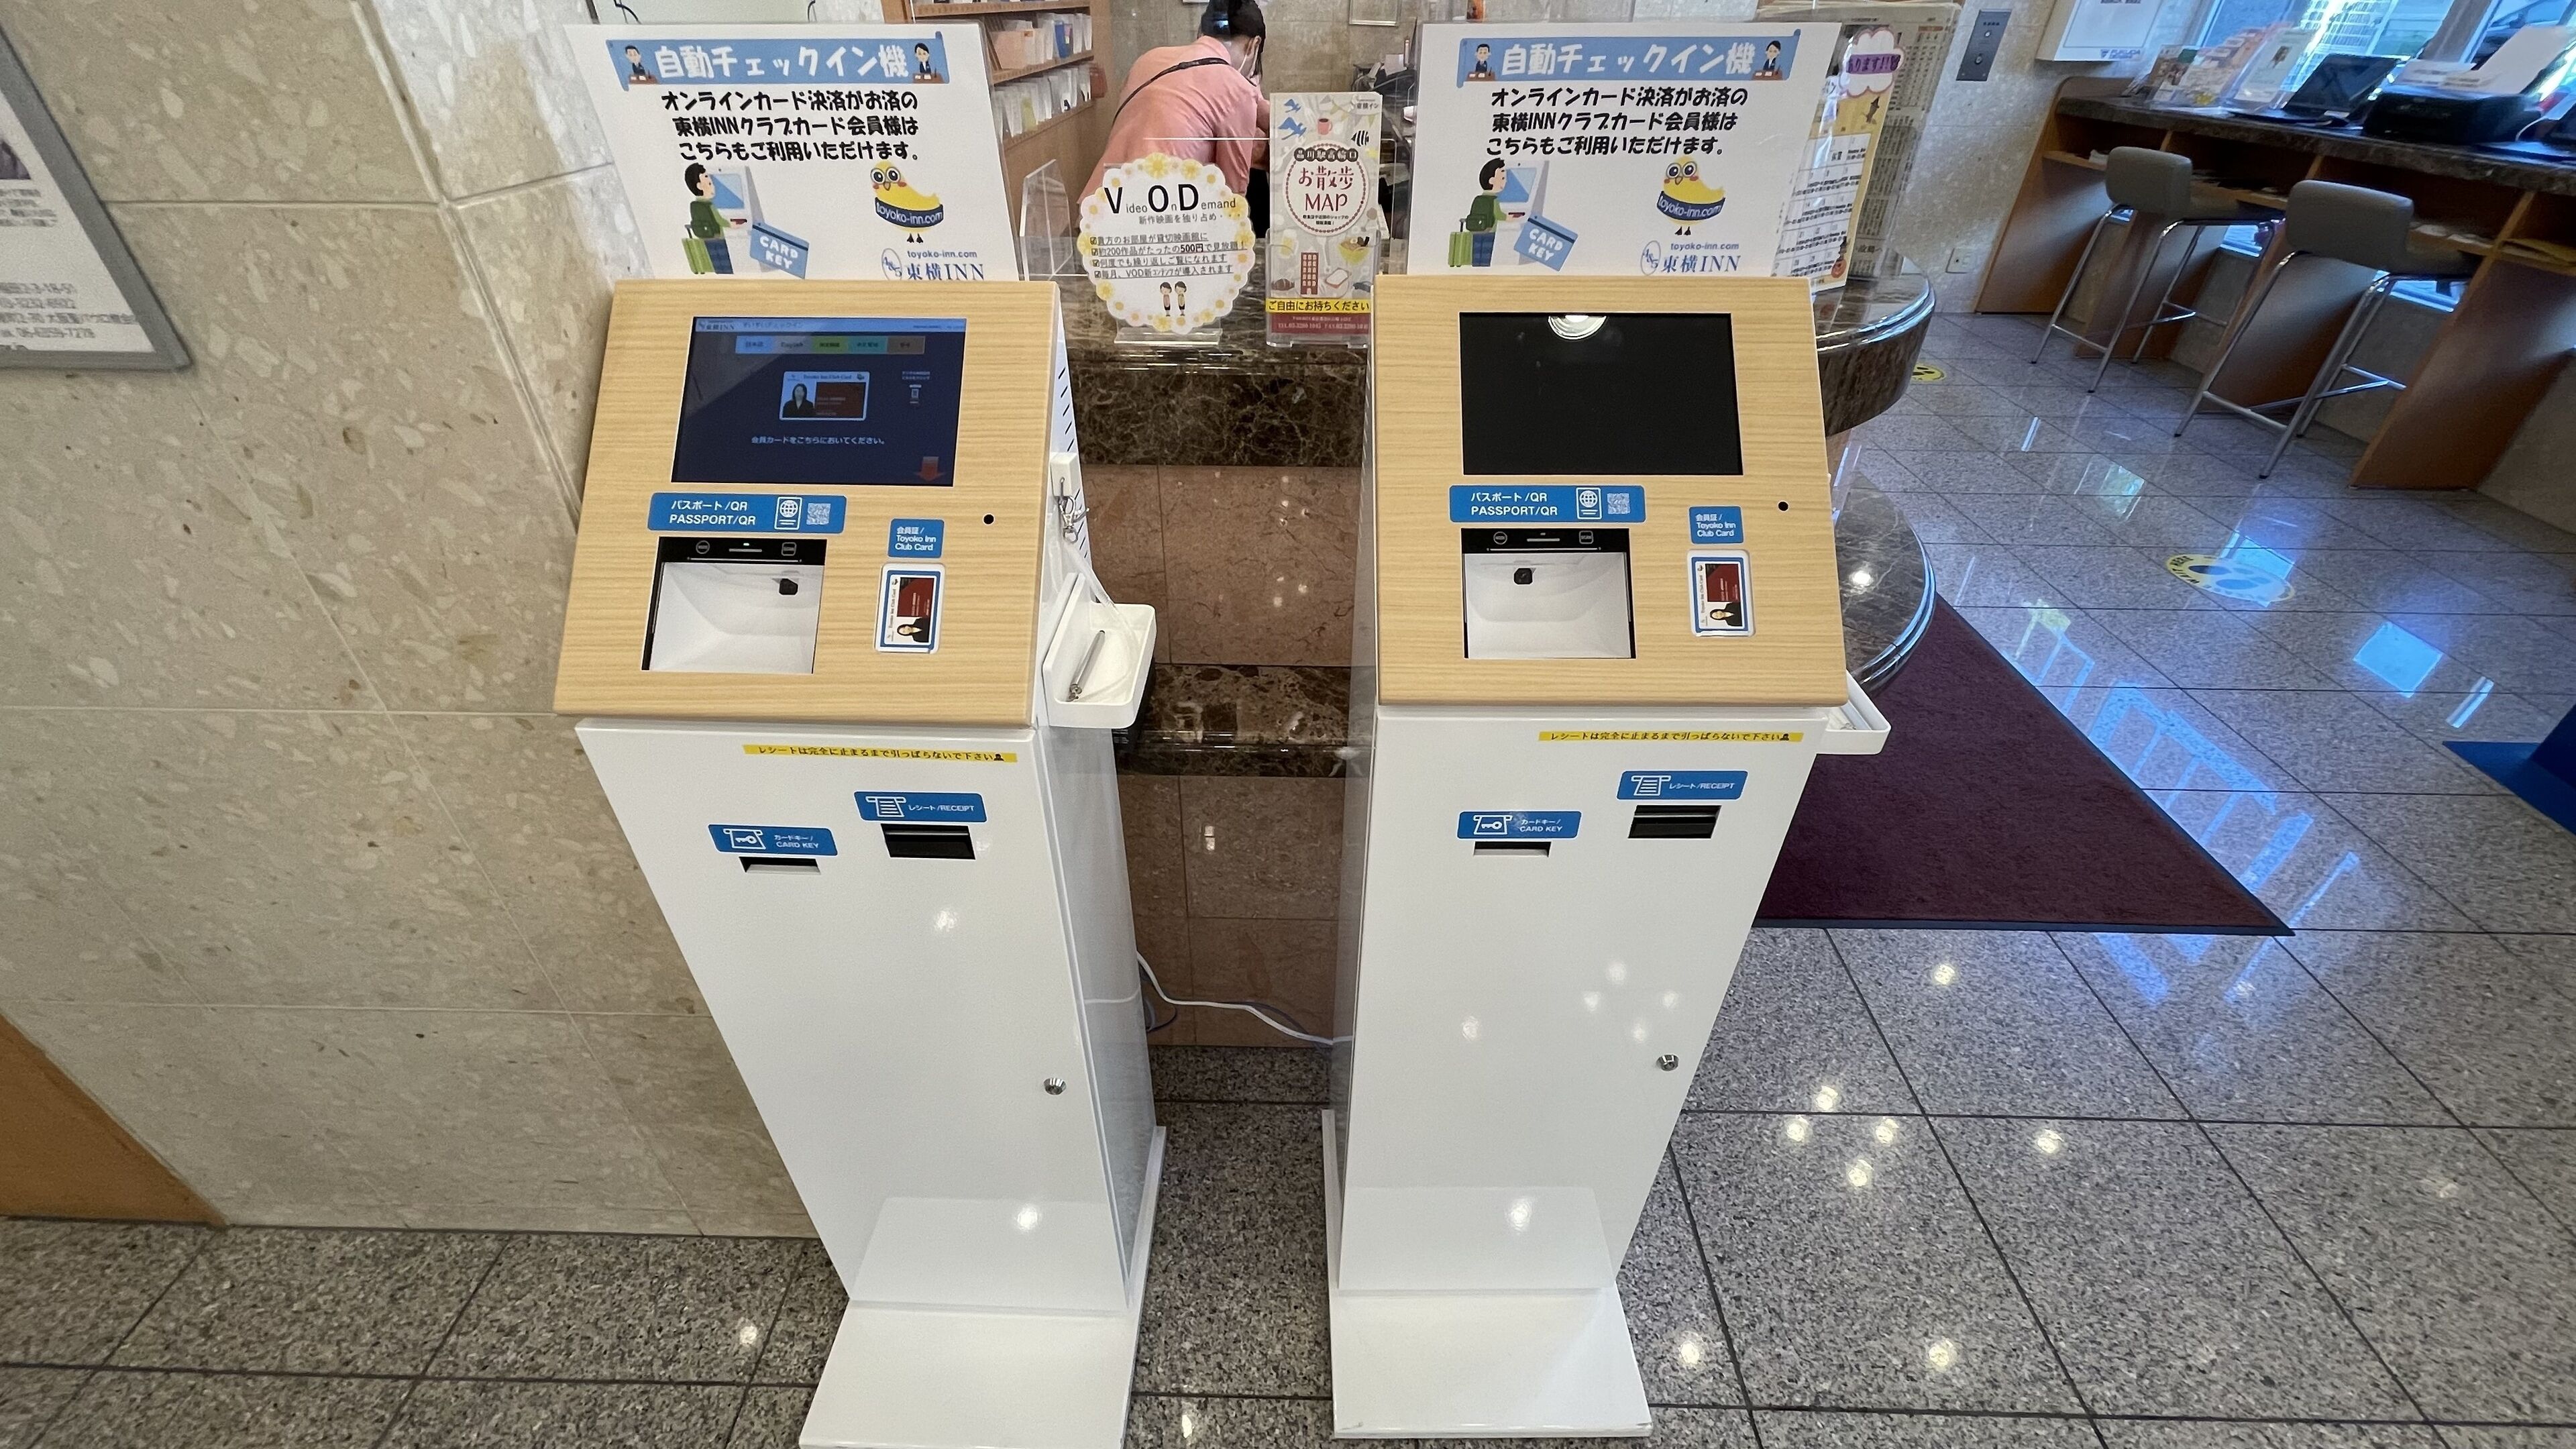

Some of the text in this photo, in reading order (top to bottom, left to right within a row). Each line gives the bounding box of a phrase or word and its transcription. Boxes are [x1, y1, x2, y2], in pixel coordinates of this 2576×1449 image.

[654, 44, 909, 79] 自動チェックイン機
[1501, 42, 1756, 76] 自動チェックイン機
[661, 91, 918, 111] オンラインカード決済がお済の
[1491, 87, 1749, 107] オンラインカード決済がお済の
[672, 115, 919, 137] 東横INNクラブカード会員様は
[1492, 111, 1739, 133] 東横INNクラブカード会員様は
[679, 141, 918, 161] こちらもご利用いただけます。
[1486, 136, 1723, 156] こちらもご利用いただけます。
[1299, 166, 1354, 191] お散歩
[1305, 193, 1348, 211] MAP
[1658, 196, 1723, 218] toyoko-inn.com
[876, 202, 943, 224] toyoko-inn.com
[759, 235, 798, 258] CARD
[1529, 228, 1563, 251] CARD
[1670, 242, 1739, 252] toyoko-inn.com
[765, 250, 792, 268] KEY
[907, 250, 977, 260] toyoko-inn.com
[1529, 242, 1554, 261] KEY
[906, 262, 984, 280] 東横INN
[1661, 255, 1741, 273] 東横INN
[1269, 301, 1369, 311] ご自由にお持ちください
[669, 514, 756, 525] PASSPORT/QR
[1471, 506, 1558, 516] PASSPORT/QR
[1697, 522, 1723, 530] Toyoko
[896, 535, 924, 543] Toyoko
